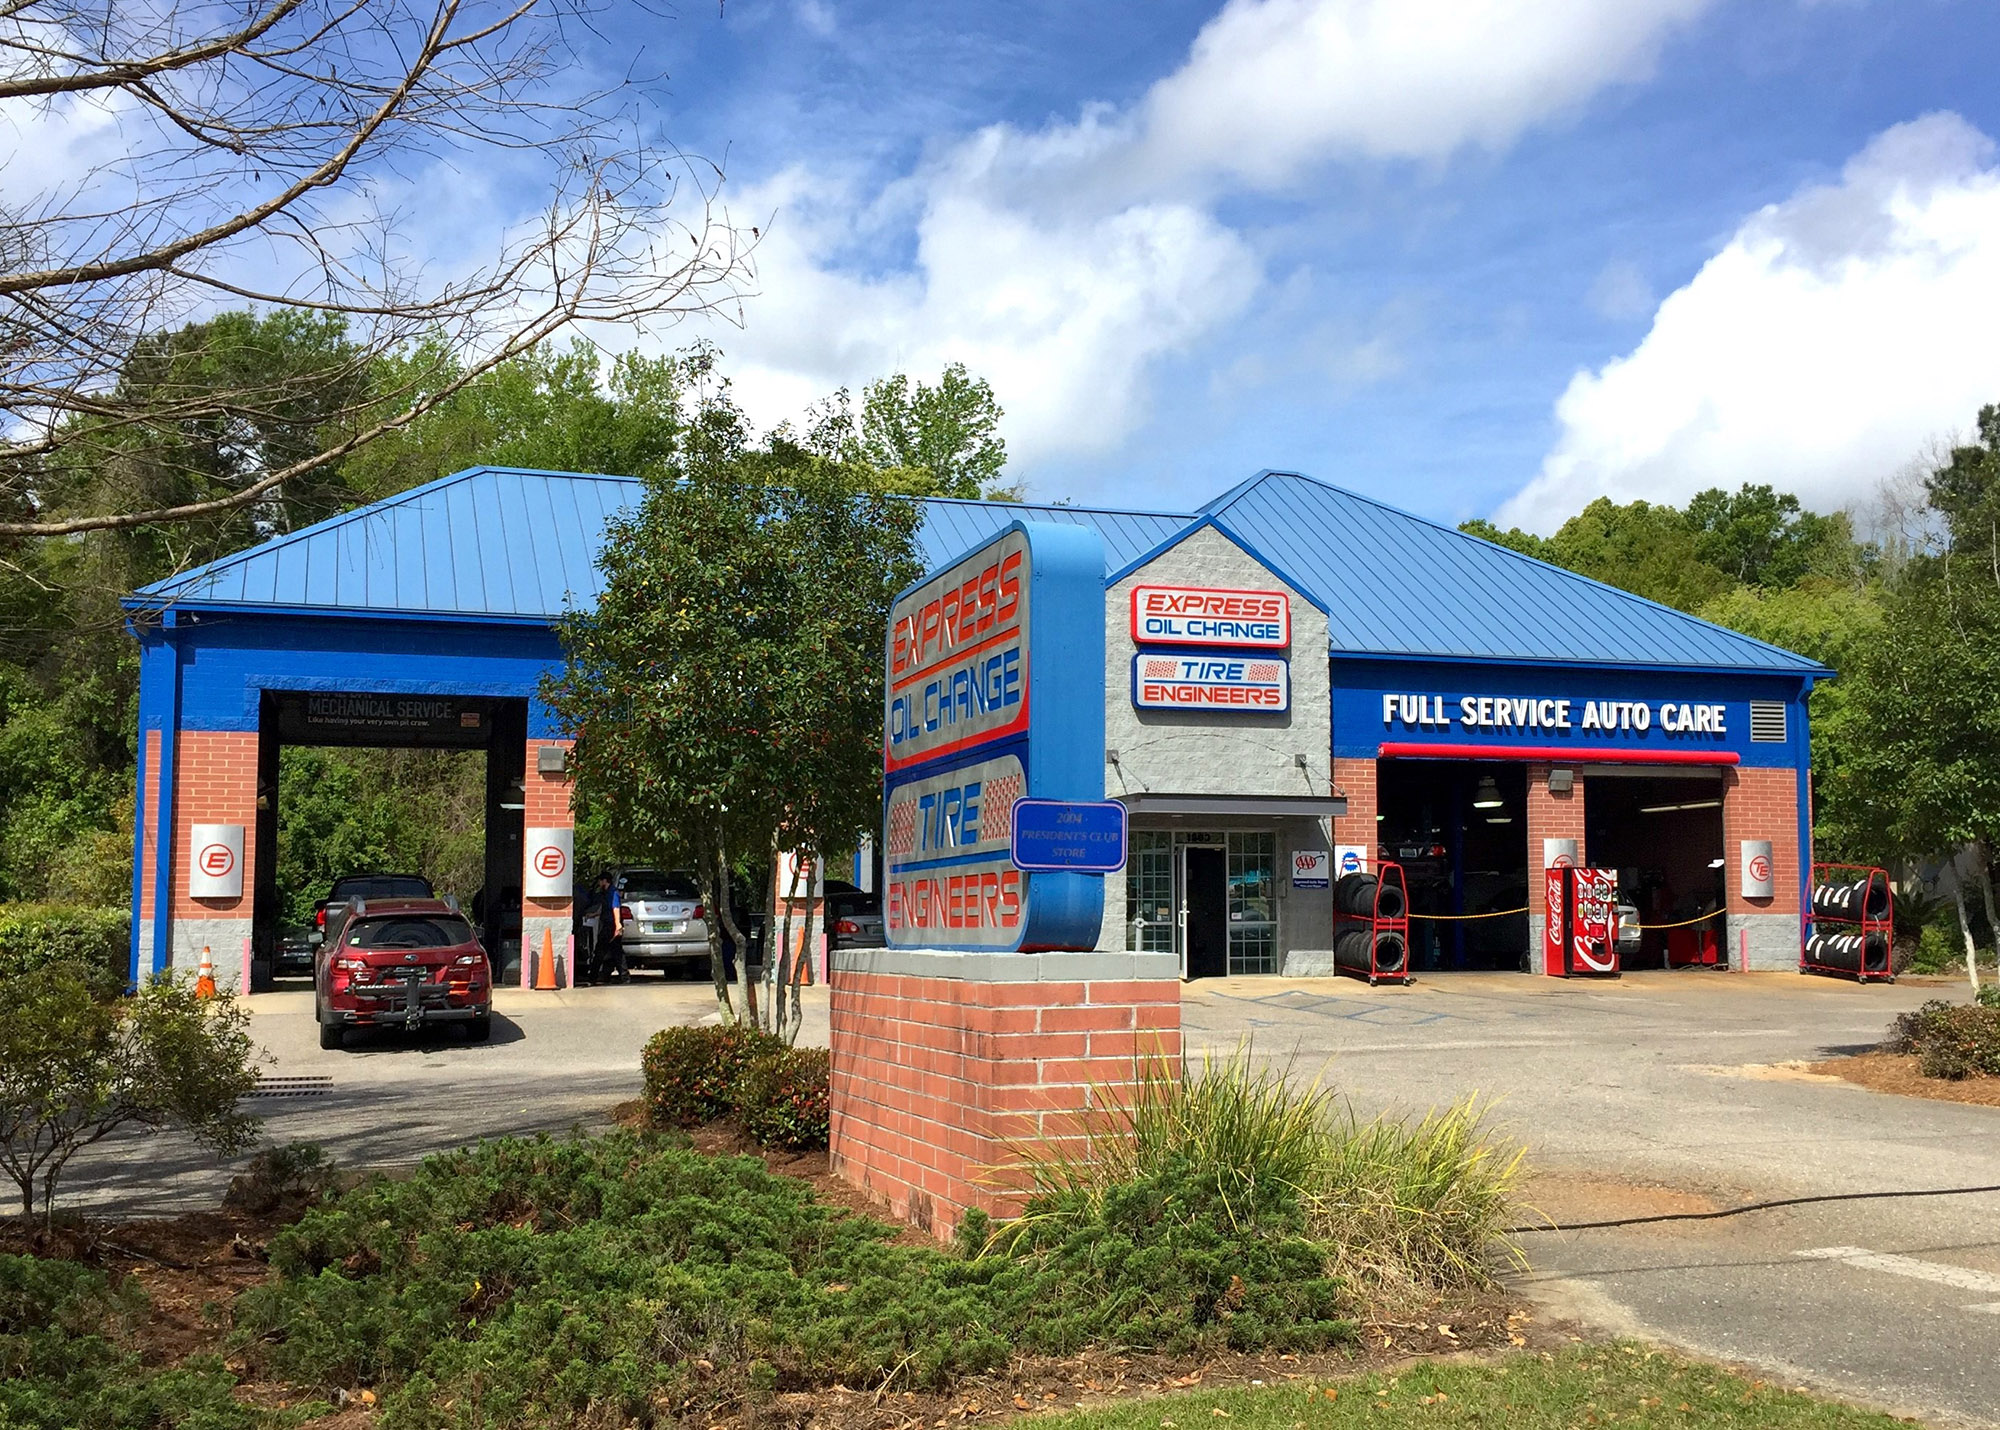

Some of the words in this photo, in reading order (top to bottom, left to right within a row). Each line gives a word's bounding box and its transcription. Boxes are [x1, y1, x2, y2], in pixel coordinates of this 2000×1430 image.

[892, 550, 1023, 675] EXPRESS
[1145, 594, 1281, 617] EXPRESS
[1146, 618, 1182, 636] OIL
[1187, 620, 1280, 640] CHANGE
[1181, 661, 1245, 681] TIRE
[891, 692, 920, 746] OIL
[924, 647, 1020, 732] CHANGE
[1143, 685, 1281, 705] ENGINEERS
[308, 698, 394, 717] MECHANICAL
[1383, 694, 1450, 725] FULL
[1460, 696, 1571, 729] SERVICE
[1582, 701, 1651, 731] AUTO
[1661, 703, 1727, 733] CARE
[919, 782, 983, 852] TIRE
[1089, 832, 1119, 843] CLUB
[206, 852, 228, 868] E
[541, 854, 560, 869] E
[1051, 848, 1086, 858] STORE
[889, 871, 1021, 930] ENGINEERS
